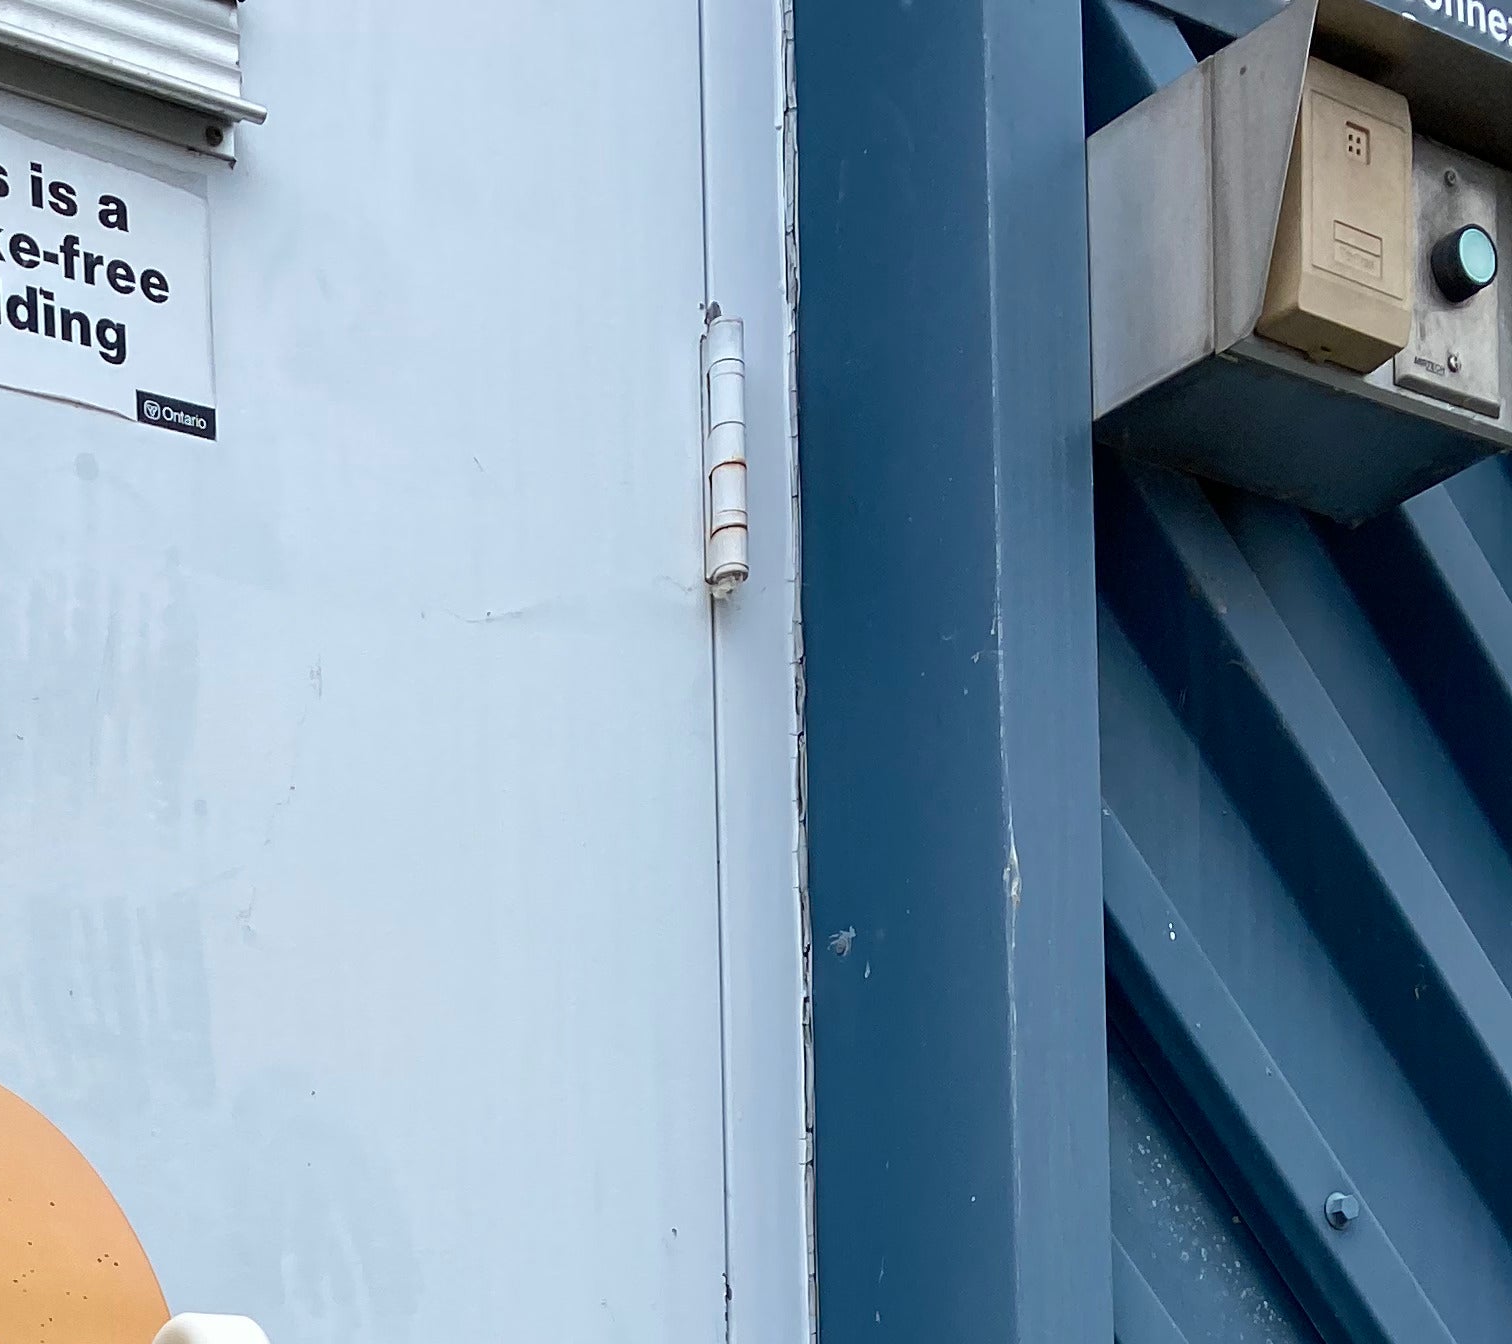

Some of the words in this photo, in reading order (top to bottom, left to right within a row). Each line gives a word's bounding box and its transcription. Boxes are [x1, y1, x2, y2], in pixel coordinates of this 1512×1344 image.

[29, 161, 78, 217] is
[97, 194, 130, 233] a
[162, 406, 207, 429] Ontario
